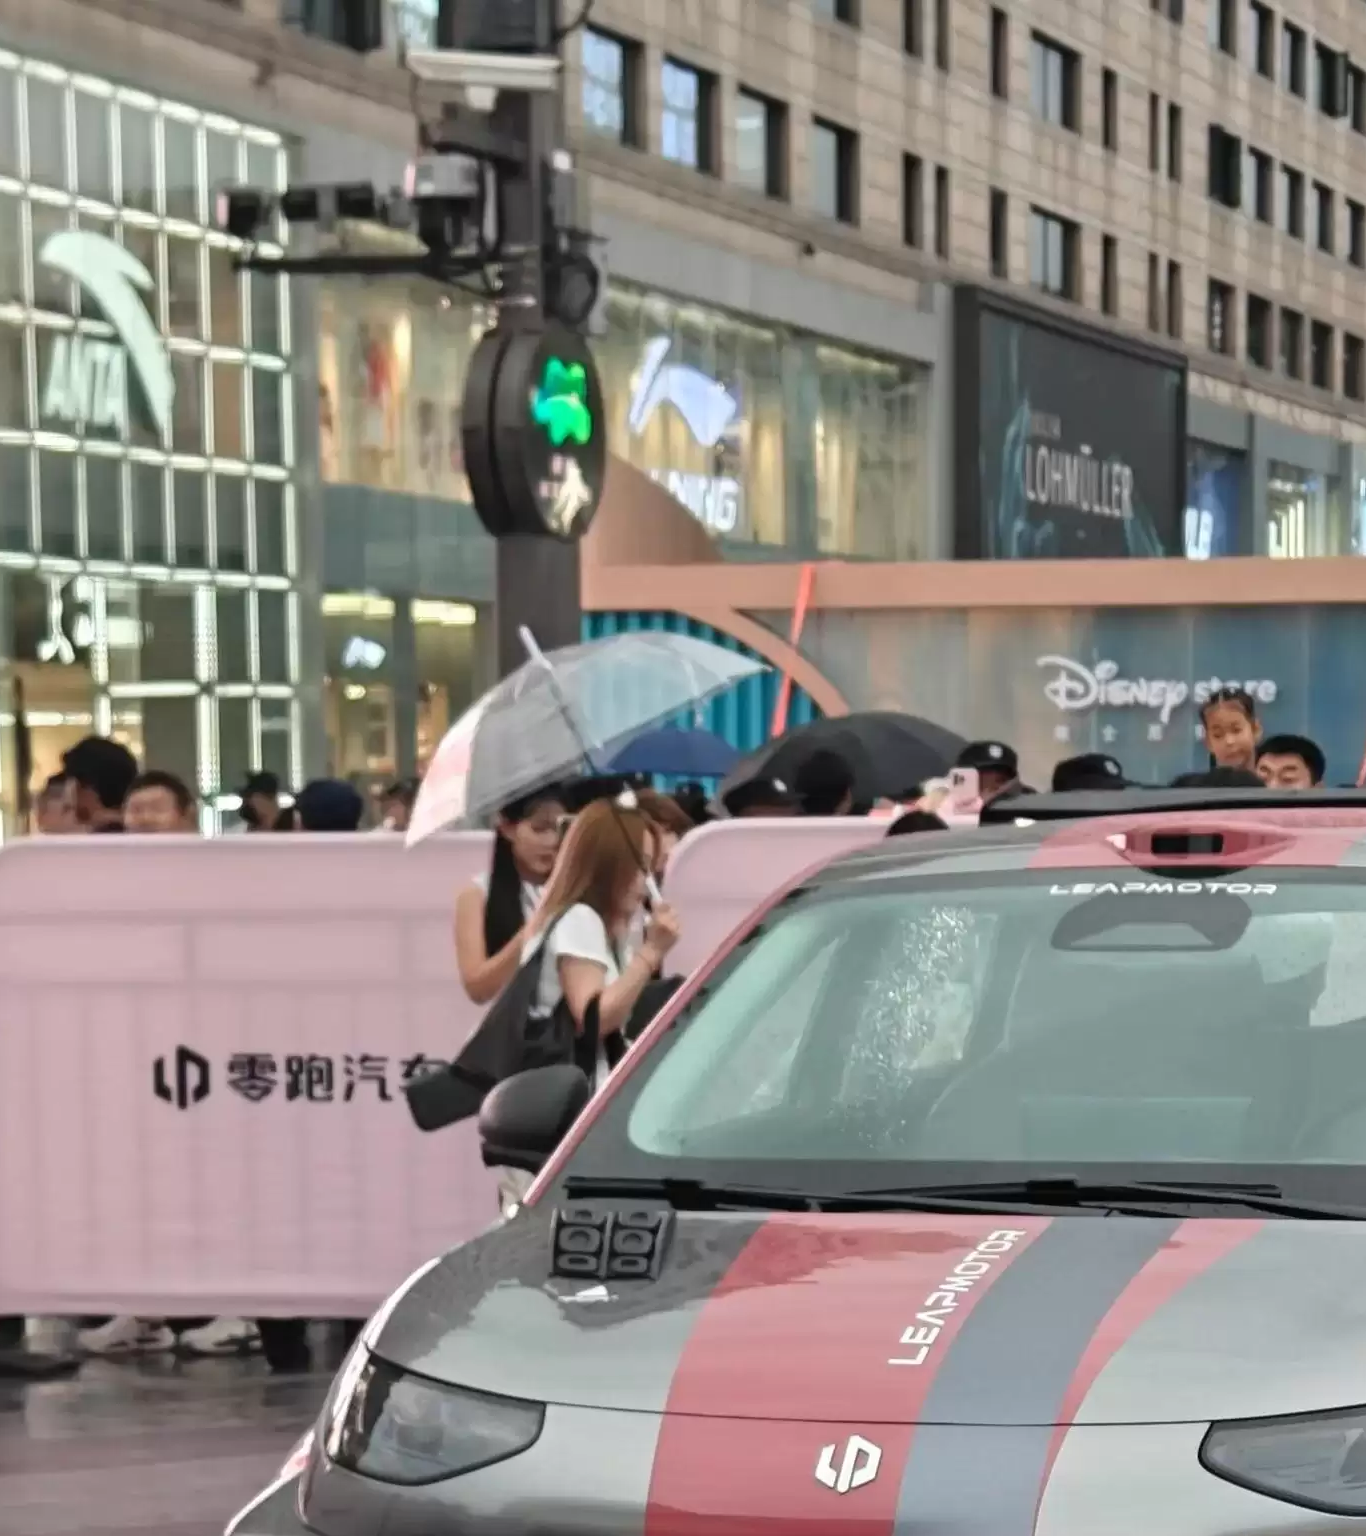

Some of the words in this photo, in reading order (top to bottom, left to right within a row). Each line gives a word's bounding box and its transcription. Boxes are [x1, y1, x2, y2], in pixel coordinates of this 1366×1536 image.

[44, 334, 128, 438] ANTA
[1026, 444, 1134, 519] LOHMÜLLER
[1050, 883, 1278, 895] LEAPMOTOR
[887, 1229, 1027, 1365] LEAPMOTOR
